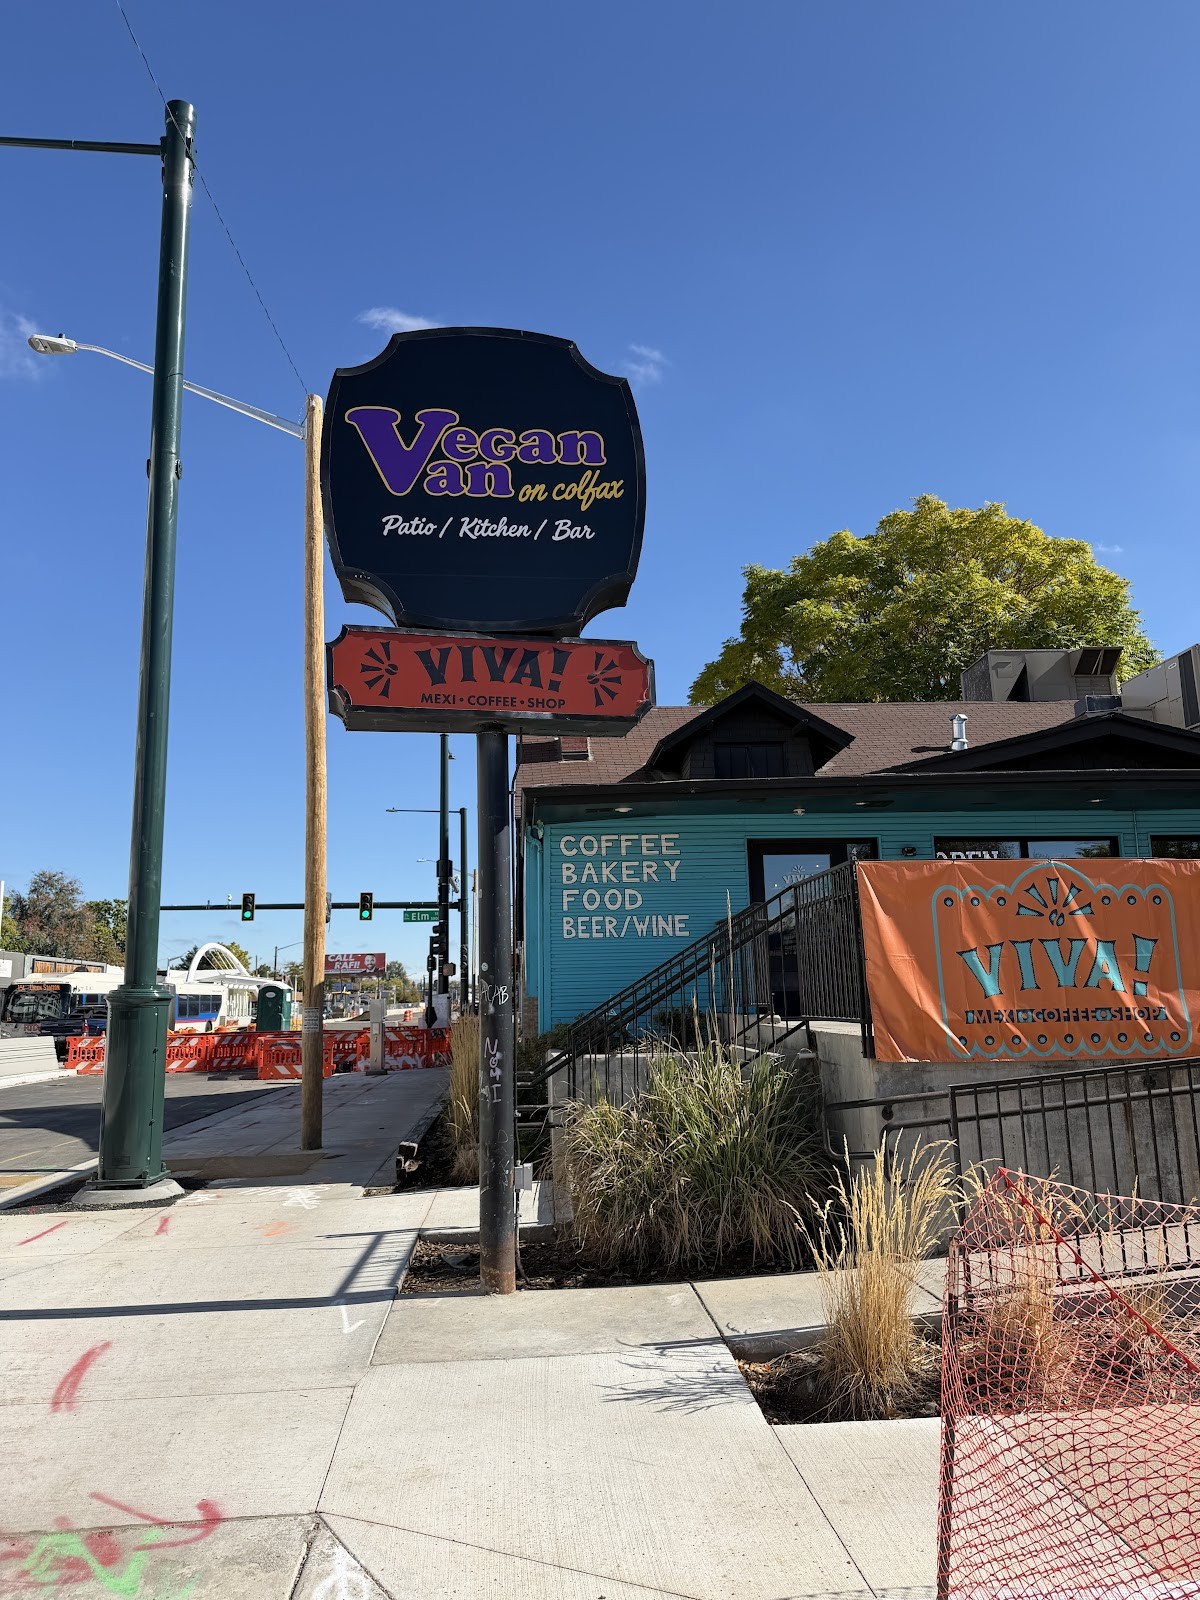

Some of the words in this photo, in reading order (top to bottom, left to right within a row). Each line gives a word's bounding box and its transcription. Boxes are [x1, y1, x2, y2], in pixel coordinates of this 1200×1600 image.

[345, 406, 606, 497] Vegan
[518, 484, 547, 502] on
[552, 470, 624, 511] colfax
[382, 514, 437, 536] Patio
[459, 517, 533, 539] Kitchen
[552, 519, 595, 541] Bar
[414, 645, 573, 692] VIVA!
[420, 693, 456, 705] MEXI
[467, 695, 517, 707] COFFEE
[528, 697, 566, 709] SHOP
[559, 833, 681, 857] COFFEE
[561, 860, 681, 884] BAKERY
[562, 888, 643, 911] FOOD
[411, 912, 430, 921] Elm
[562, 914, 690, 939] BEER/WINE
[327, 954, 355, 962] CALL
[956, 933, 1159, 999] VIVA!
[976, 1009, 1016, 1024] MEXI
[1033, 1007, 1097, 1023] COFFEE
[1111, 1006, 1160, 1021] SHOP
